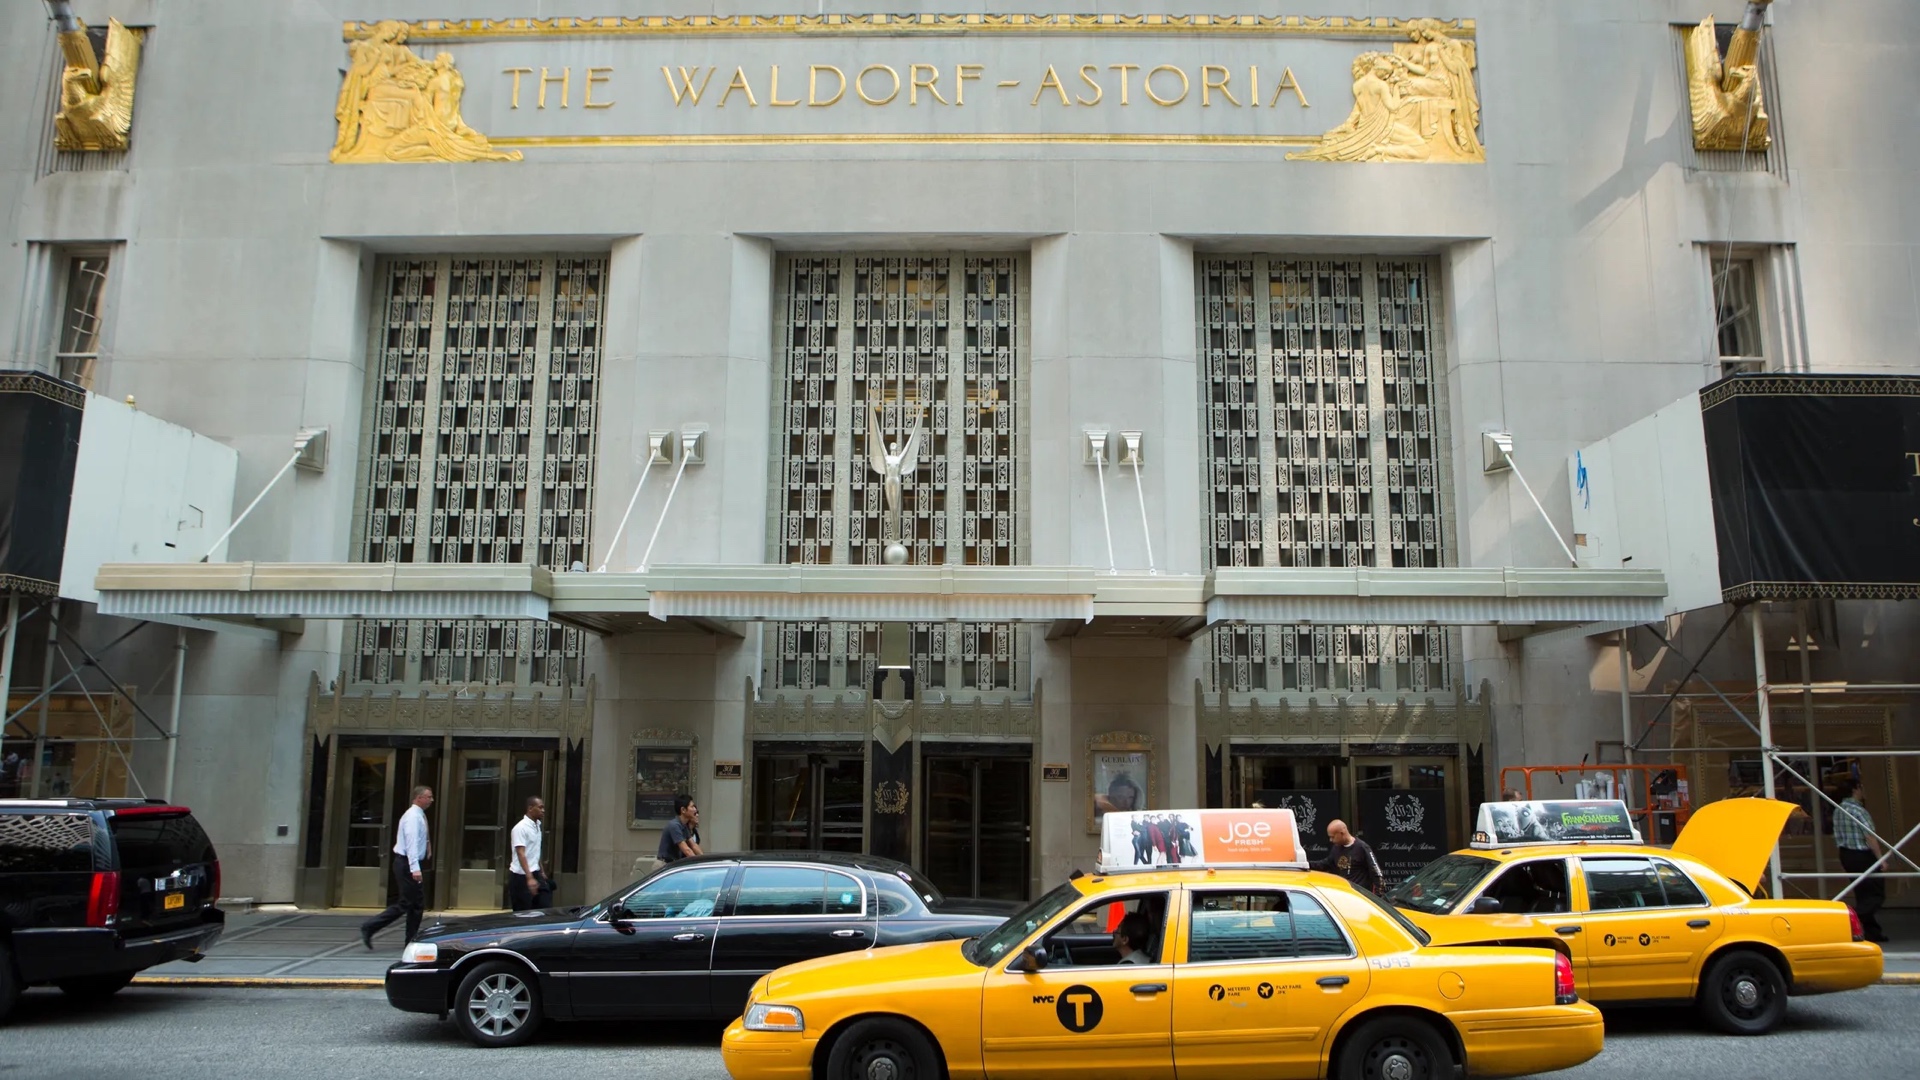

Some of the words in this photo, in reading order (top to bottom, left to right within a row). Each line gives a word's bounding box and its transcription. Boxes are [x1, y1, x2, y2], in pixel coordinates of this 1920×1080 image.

[503, 67, 615, 108] THE
[1033, 995, 1054, 1003] NYC
[1066, 993, 1093, 1027] T
